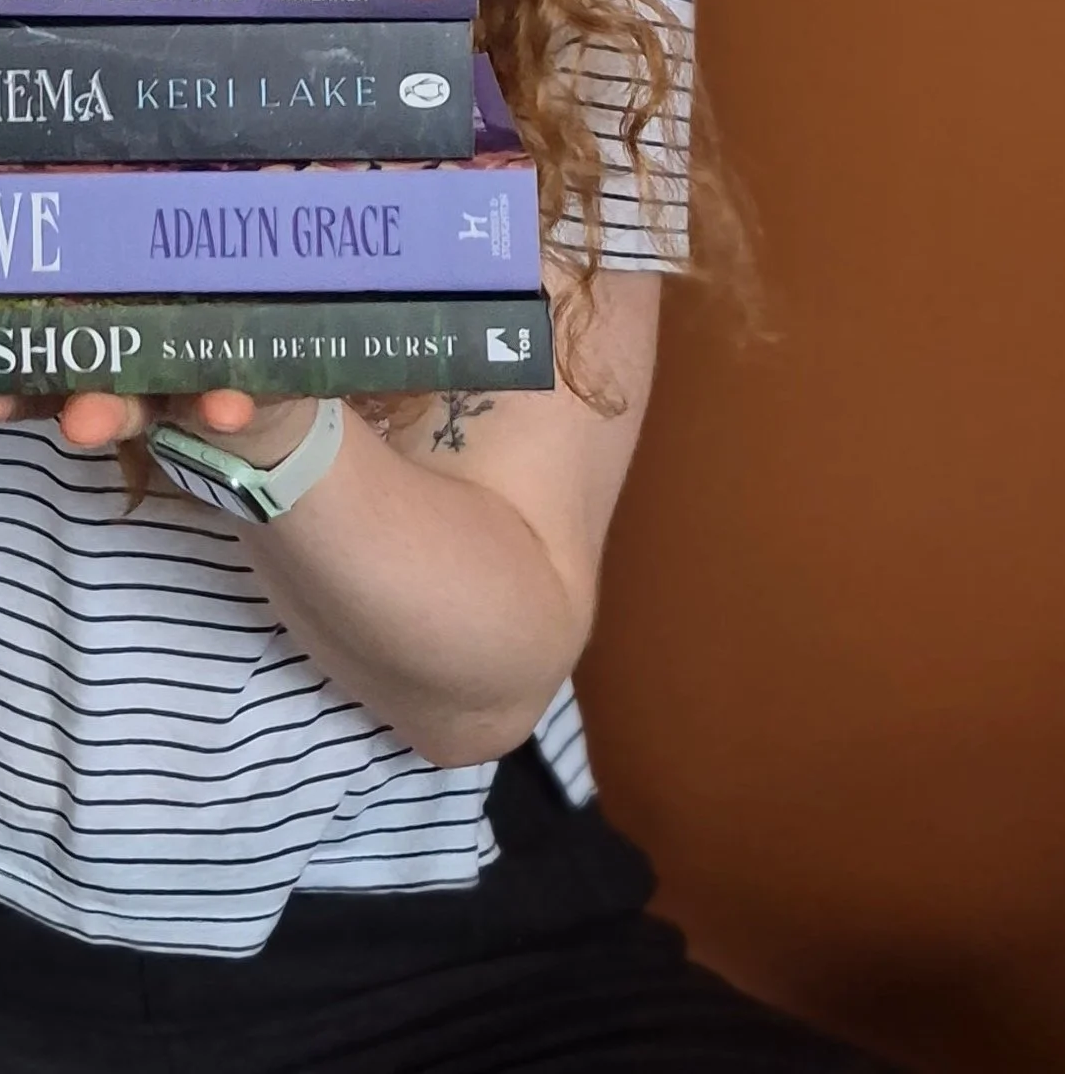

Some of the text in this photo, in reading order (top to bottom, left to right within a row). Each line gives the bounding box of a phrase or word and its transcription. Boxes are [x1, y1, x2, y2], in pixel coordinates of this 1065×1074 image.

[137, 76, 378, 110] KERI LAKE
[150, 205, 401, 260] ADALYN GRACE
[162, 336, 458, 361] SARAH BETH DURST
[518, 328, 532, 362] TOR
